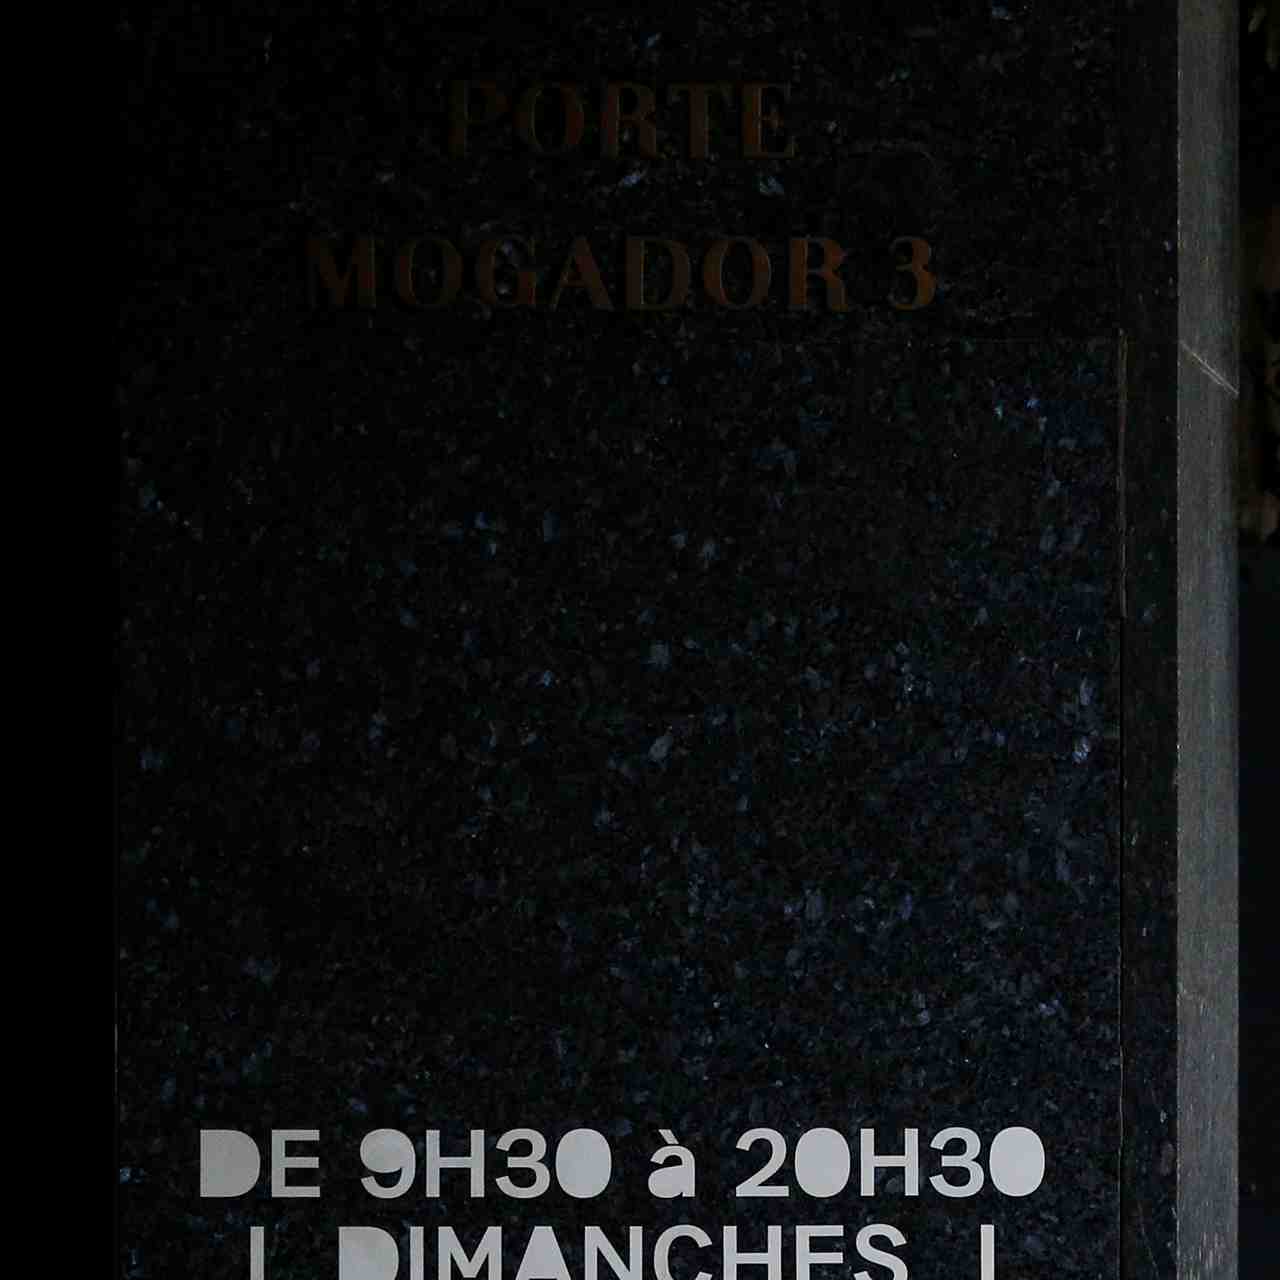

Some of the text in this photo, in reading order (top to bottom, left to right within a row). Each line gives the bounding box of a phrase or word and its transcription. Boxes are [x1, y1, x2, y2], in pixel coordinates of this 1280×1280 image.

[447, 79, 796, 162] PORTE
[307, 237, 941, 311] MOGADOR 3
[200, 1126, 1046, 1199] DE 9H30 à 20H30
